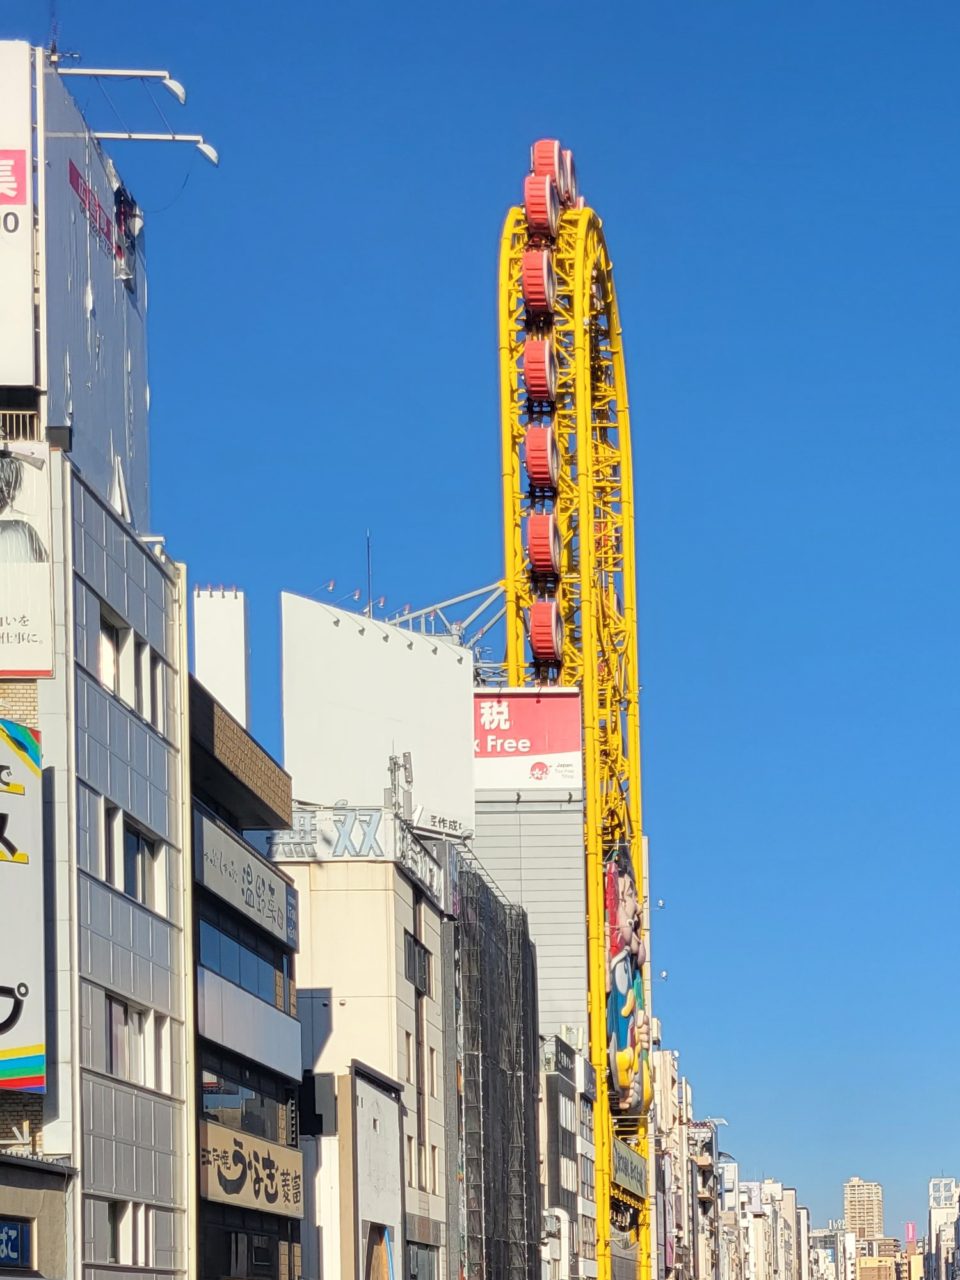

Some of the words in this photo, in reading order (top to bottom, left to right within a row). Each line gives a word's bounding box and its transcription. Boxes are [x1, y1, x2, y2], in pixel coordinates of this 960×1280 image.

[0, 613, 30, 627] いを
[480, 700, 511, 730] 税
[486, 735, 531, 753] Free
